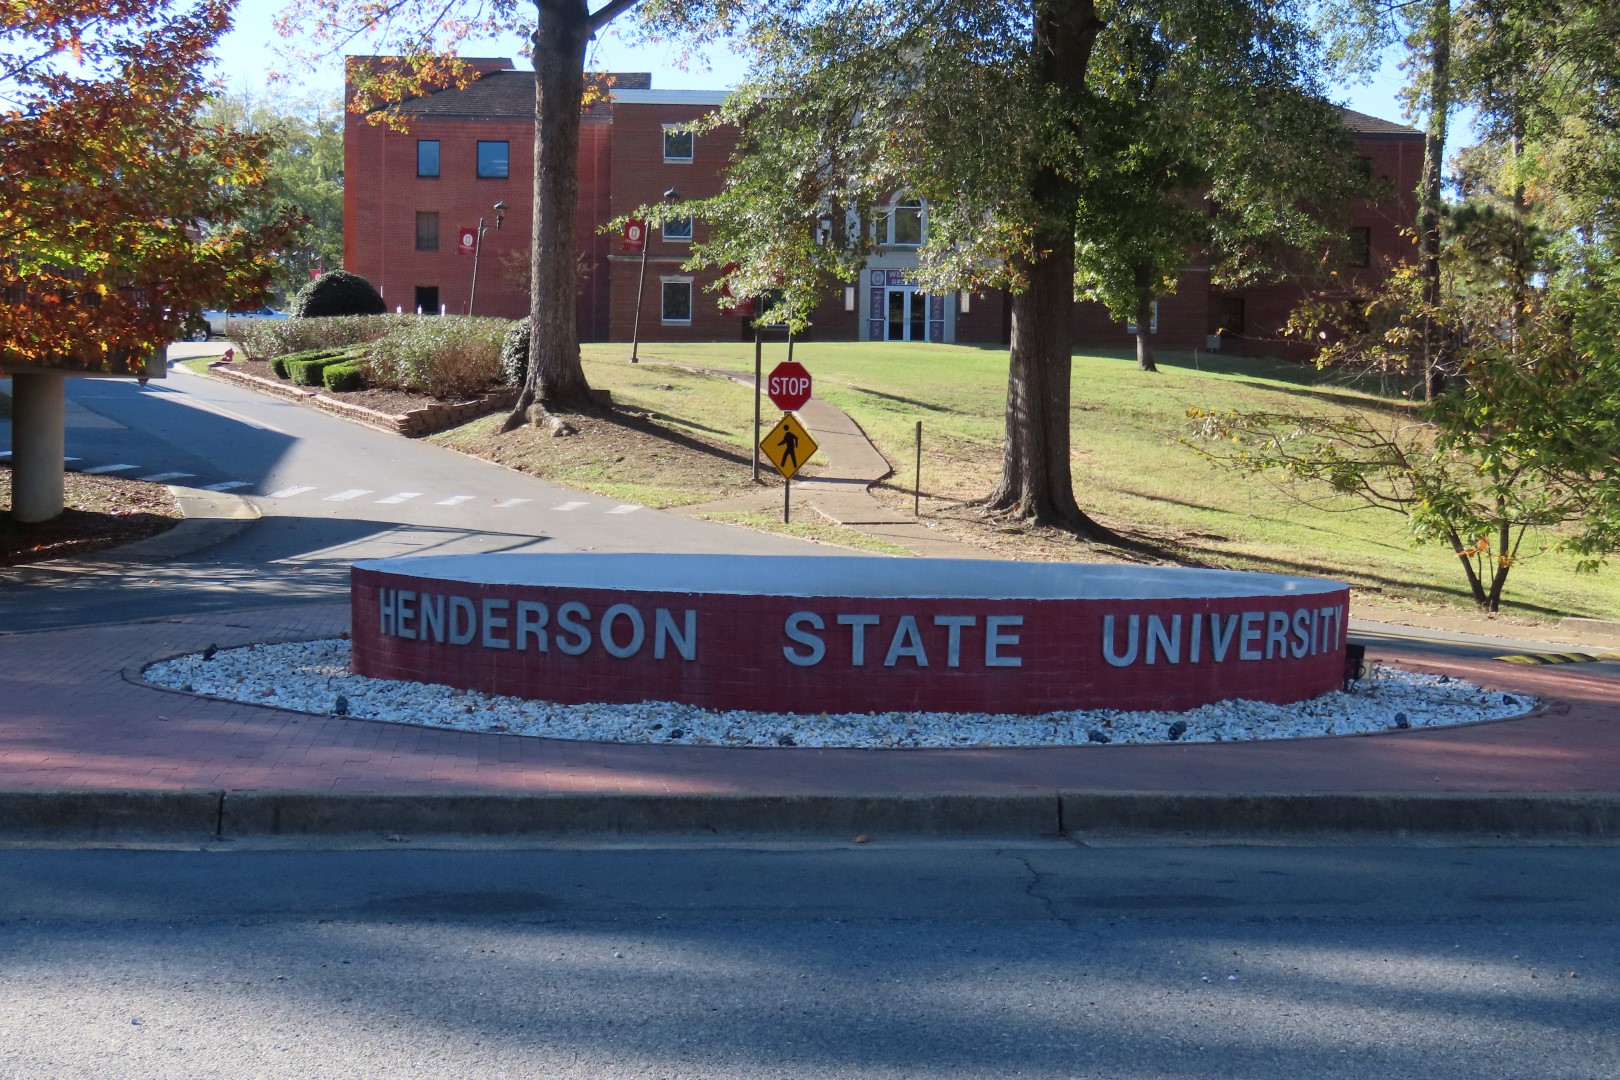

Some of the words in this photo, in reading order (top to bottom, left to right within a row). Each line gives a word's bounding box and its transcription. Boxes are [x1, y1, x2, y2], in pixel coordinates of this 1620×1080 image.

[771, 377, 809, 395] STOP
[379, 587, 697, 661] HENDERSON
[782, 610, 1024, 667] STATE
[1102, 604, 1344, 667] UNIVERSITY
